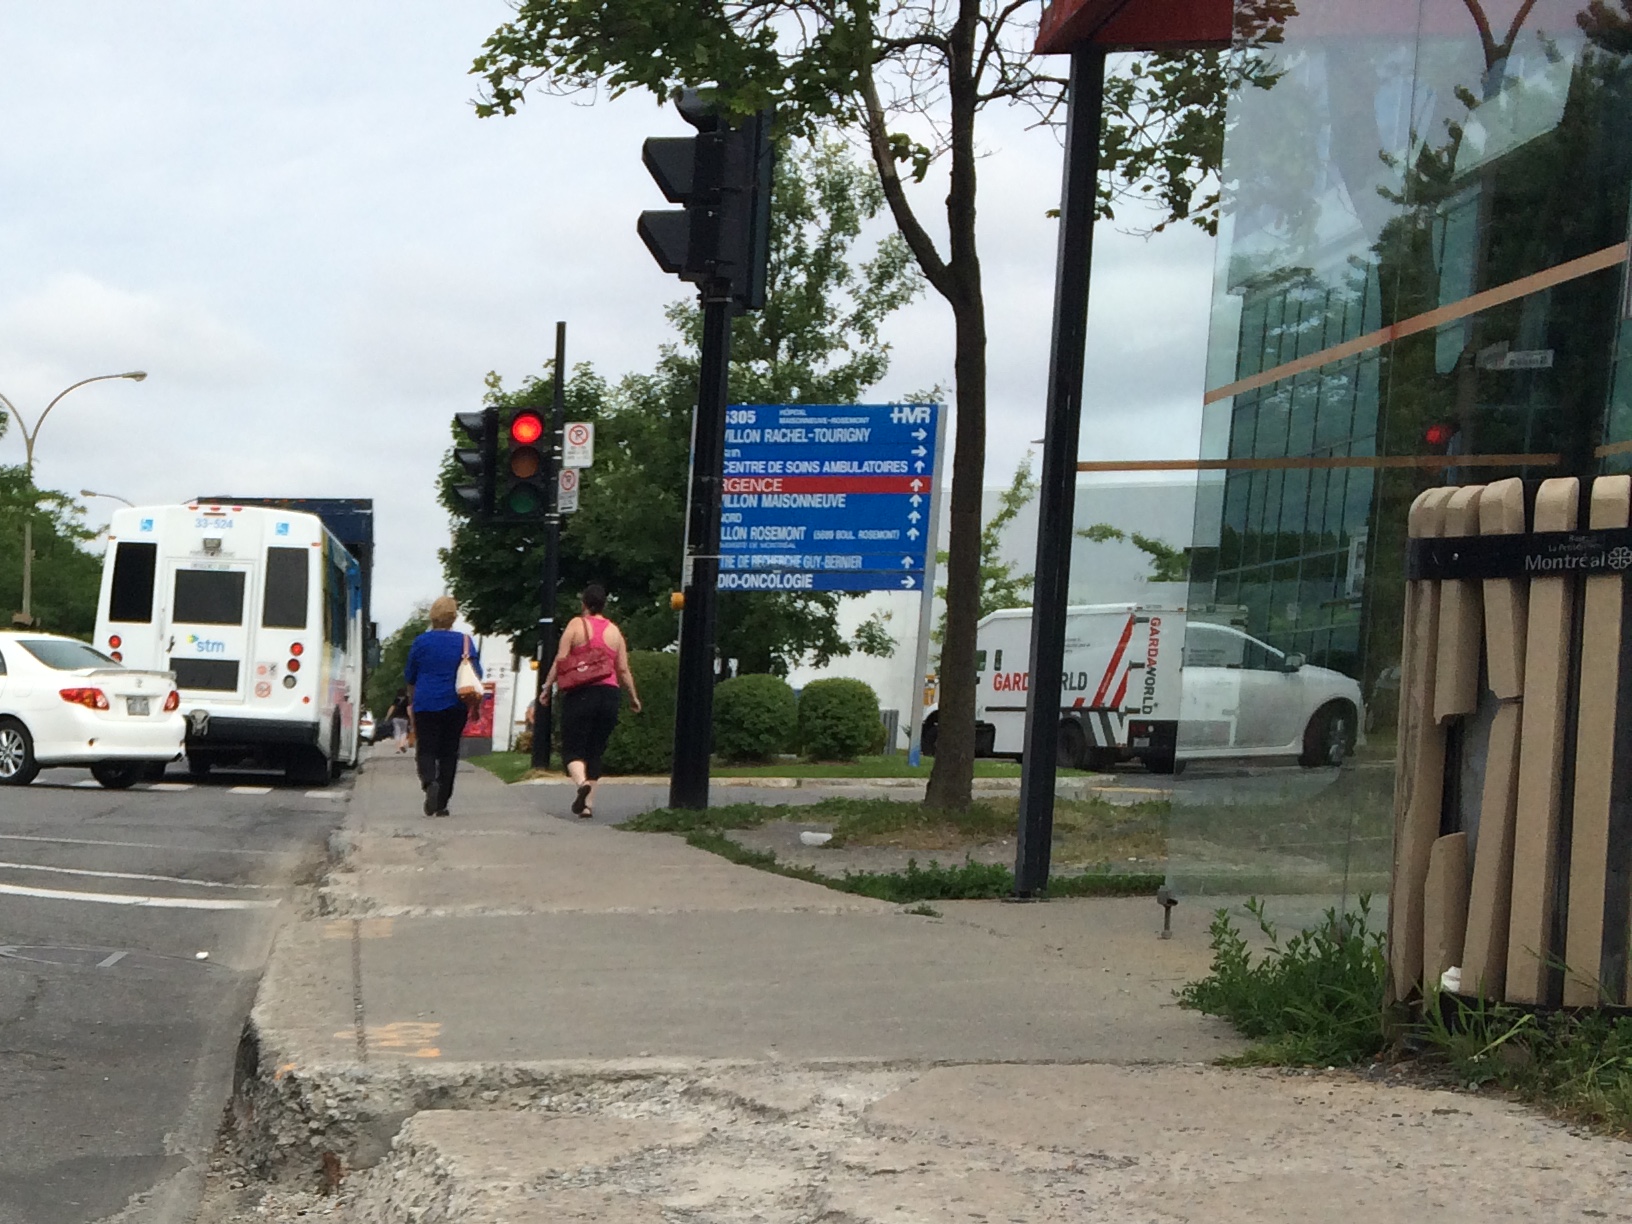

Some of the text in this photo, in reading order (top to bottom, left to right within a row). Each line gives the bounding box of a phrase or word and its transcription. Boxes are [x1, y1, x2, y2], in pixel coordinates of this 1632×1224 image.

[764, 428, 871, 443] RACHEL-TOURIGNY
[768, 461, 784, 473] DE
[785, 461, 820, 474] SOINS
[822, 460, 908, 474] AMBULATOIRES
[761, 494, 847, 508] MAISONNEUVE
[750, 526, 807, 540] ROSEMONT
[737, 555, 750, 568] DE
[803, 555, 862, 569] GUY-BERNIER
[1525, 551, 1605, 570] Montréal
[718, 573, 813, 588] DIO-ONCOLOGIE
[197, 639, 225, 653] stm
[1142, 616, 1162, 715] GARDAWORLD
